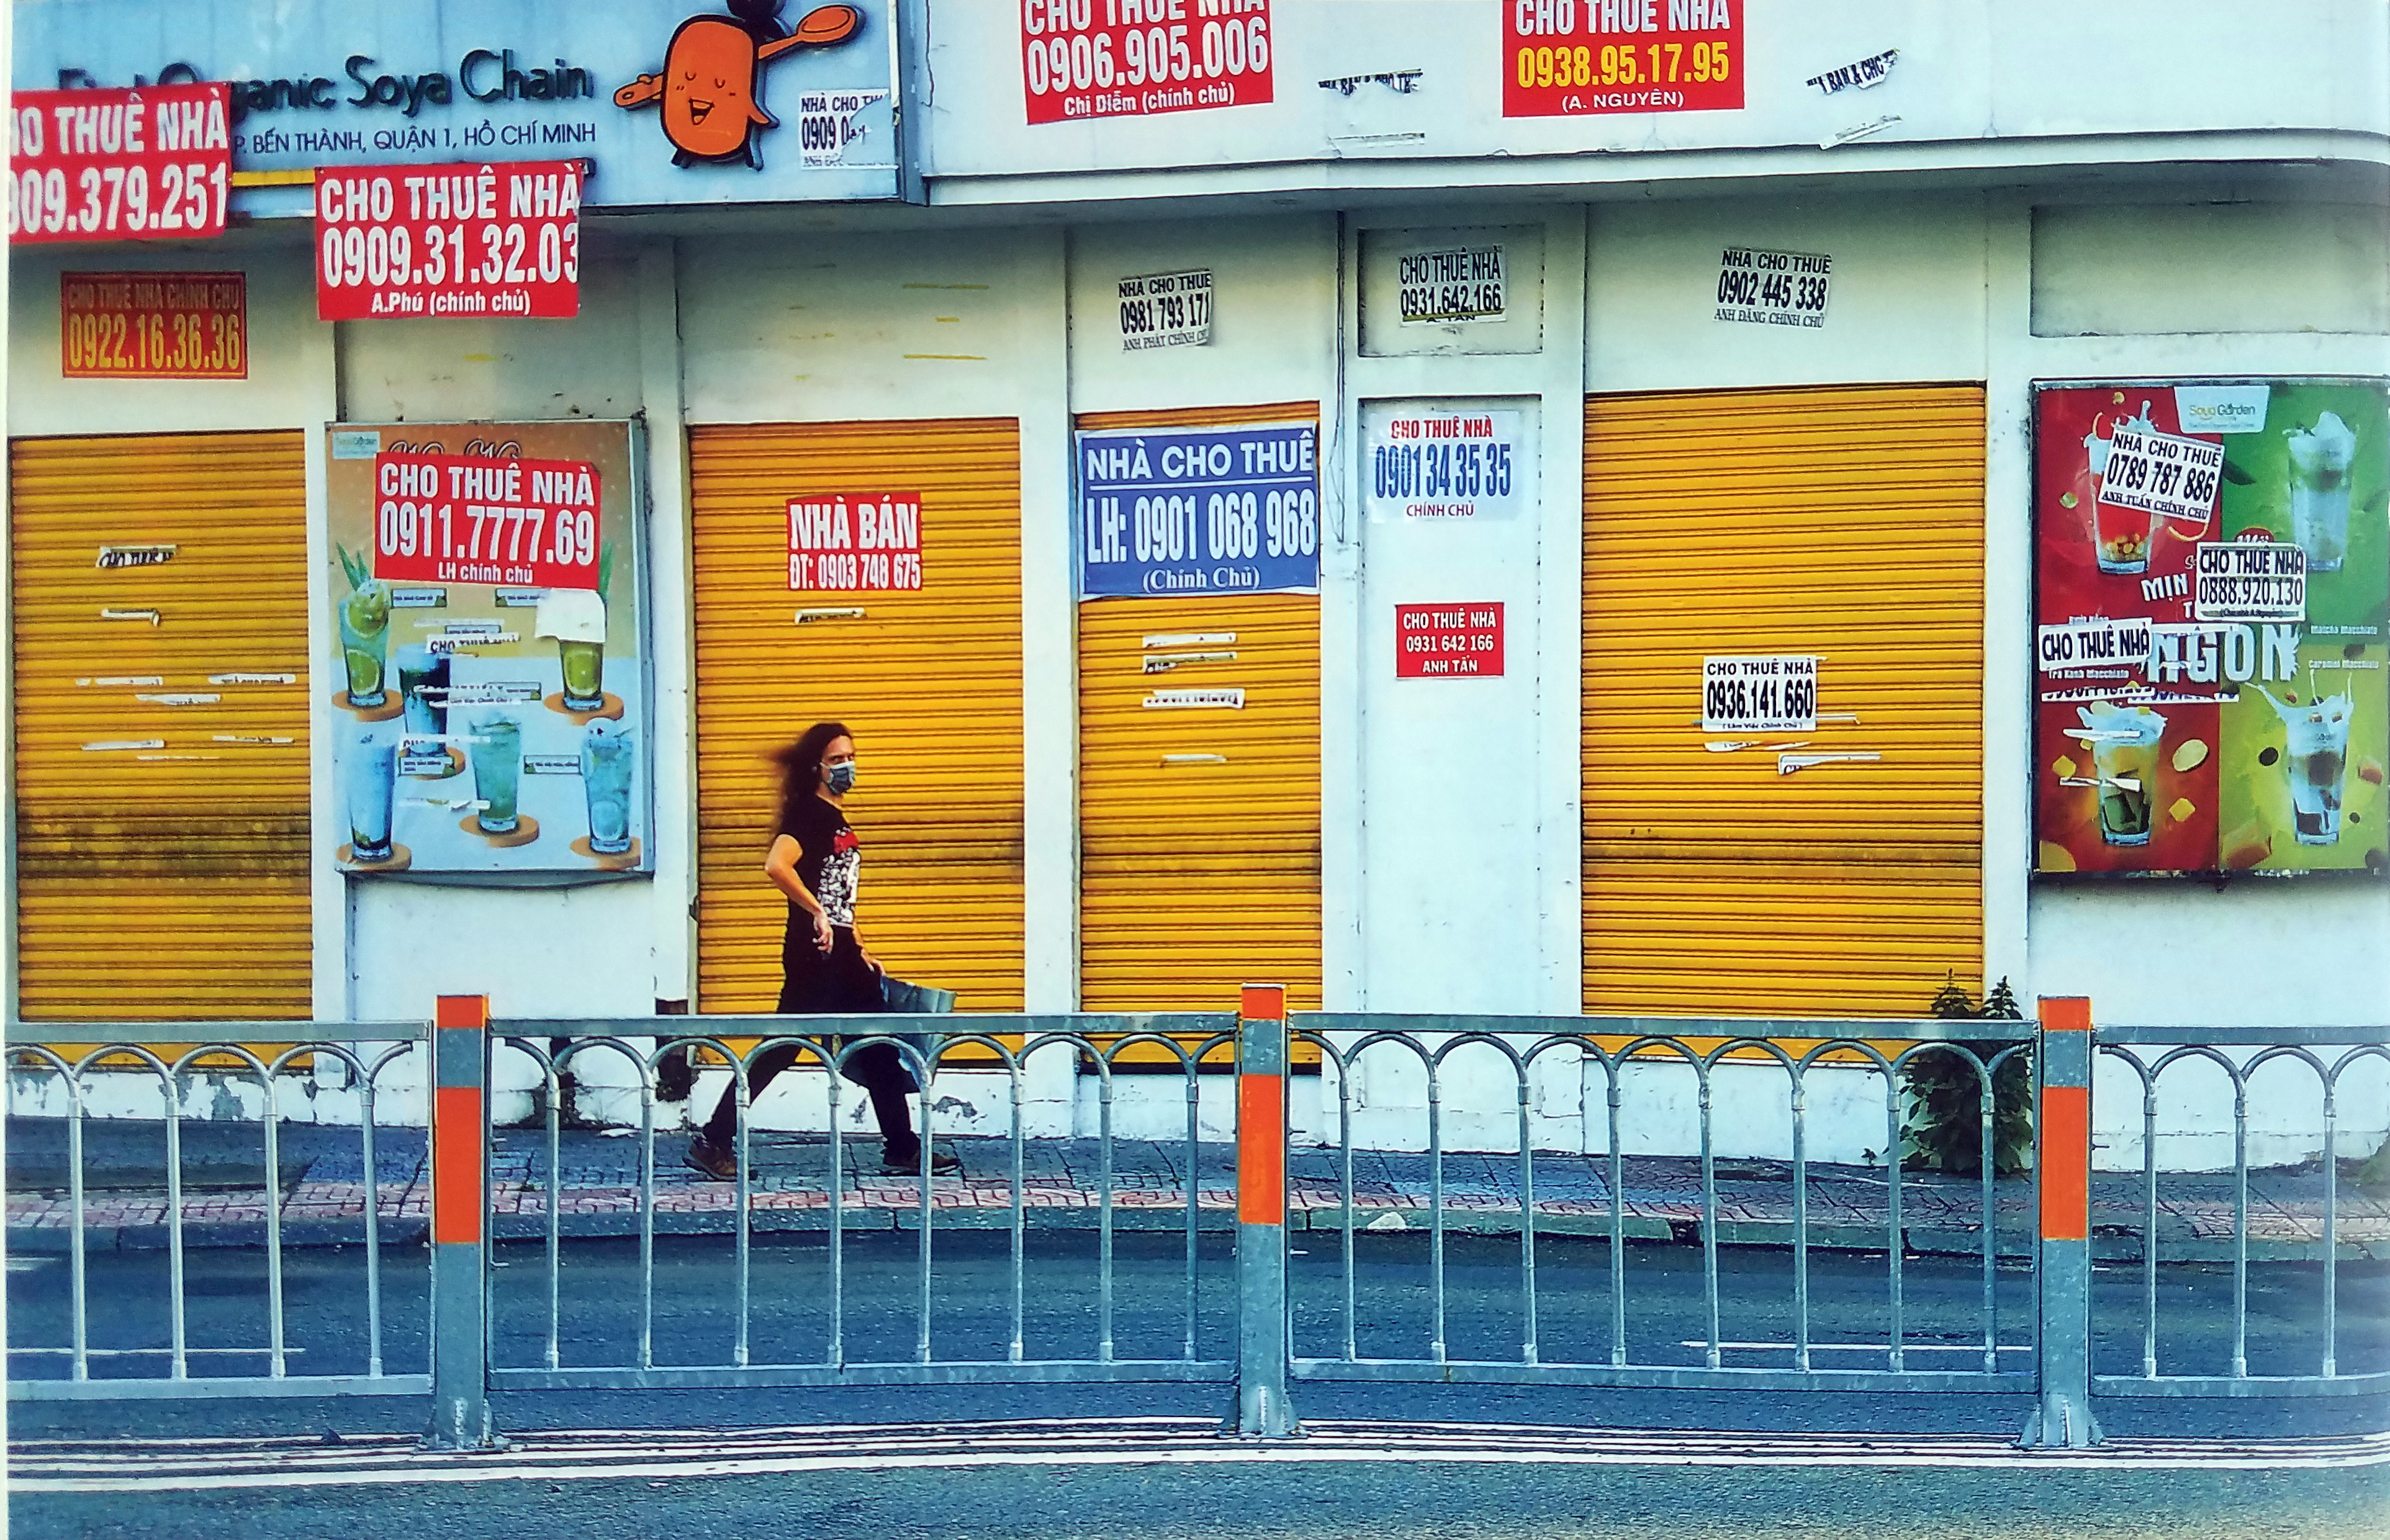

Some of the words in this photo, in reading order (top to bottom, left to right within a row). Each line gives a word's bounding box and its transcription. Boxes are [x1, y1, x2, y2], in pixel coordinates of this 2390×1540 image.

[1516, 0, 1575, 35] CHO
[1027, 16, 1268, 95] 0906.905.006
[1517, 41, 1729, 88] 0938.95.17.95
[345, 55, 453, 118] Soya
[459, 48, 594, 102] Chain
[1064, 95, 1091, 117] Chị
[1142, 85, 1193, 114] (chính
[1198, 80, 1235, 106] chủ)
[1562, 95, 1587, 112] (A.
[1593, 89, 1684, 109] NGUYÊN)
[801, 92, 827, 112] NHÀ
[832, 96, 859, 112] CHO
[55, 92, 145, 154] THUÊ
[156, 87, 228, 151] NHÀ
[253, 127, 289, 153] BẾN
[296, 127, 366, 153] THÀNH,
[374, 125, 436, 152] QUẬN
[465, 118, 495, 146] HỒ
[500, 119, 538, 145] CHÍ
[542, 123, 597, 145] MINH
[801, 115, 836, 150] 0909
[322, 176, 394, 223] CHO
[404, 164, 497, 220] THUÊ
[510, 162, 580, 218] NHÀ
[323, 222, 579, 288] 0909.31.32.03
[1400, 255, 1428, 284] CHO
[1432, 246, 1468, 282] THUÊ
[1757, 253, 1788, 271] CHO
[1792, 254, 1832, 274] THUÊ
[371, 290, 424, 313] A.Phú
[429, 289, 486, 316] (chính
[492, 287, 531, 315] chủ)
[1149, 277, 1175, 294] CHO
[1718, 269, 1759, 305] 0902
[1761, 273, 1793, 308] 445
[1795, 276, 1827, 311] 338
[1121, 299, 1155, 334] 0981
[1158, 295, 1184, 330] 793
[1188, 291, 1209, 326] 171
[70, 313, 240, 369] 0922.16.36.36
[1391, 420, 1420, 439] CHO
[1423, 415, 1459, 438] THUÊ
[1463, 414, 1493, 438] NHÀ
[1086, 438, 1153, 480] NHÀ
[1161, 443, 1232, 479] CHO
[1240, 430, 1314, 475] THUÊ
[2148, 439, 2178, 459] CHO
[380, 462, 438, 498] CHO
[448, 462, 521, 503] THUÊ
[532, 464, 595, 506] NHÀ
[2107, 453, 2148, 490] 0789
[2150, 461, 2183, 496] 787
[2183, 467, 2216, 503] 886
[789, 495, 852, 549] NHÀ
[857, 493, 918, 550] BÁN
[1406, 501, 1445, 516] CHÍNH
[1448, 500, 1474, 516] CHỦ
[379, 500, 595, 566] 0911.7777.69
[1086, 497, 1128, 564] LH:
[1134, 495, 1197, 562] 0901
[1207, 491, 1259, 560] 068
[1266, 488, 1316, 558] 968
[438, 562, 457, 580] LH
[460, 562, 502, 582] chính
[505, 563, 534, 584] chủ
[818, 553, 857, 589] 0903
[893, 553, 921, 589] 675
[2199, 548, 2230, 574] CHO
[1143, 567, 1209, 594] (Chính
[1212, 565, 1261, 591] Chủ)
[2140, 573, 2188, 601] MỊN
[2199, 577, 2302, 605] 0888.920.130
[1403, 613, 1429, 629] CHO
[1431, 607, 1466, 629] THUÊ
[1470, 606, 1497, 628] NHÀ
[1405, 636, 1438, 652] 0931
[1441, 634, 1466, 652] 642
[1470, 634, 1494, 651] 166
[2042, 632, 2073, 662] CHO
[2077, 623, 2115, 659] THUÊ
[2119, 621, 2150, 657] NHÀ
[1422, 660, 1449, 673] ANH
[1707, 662, 1737, 675] CHO
[1741, 658, 1780, 675] THUÊ
[1784, 657, 1813, 675] NHÀ
